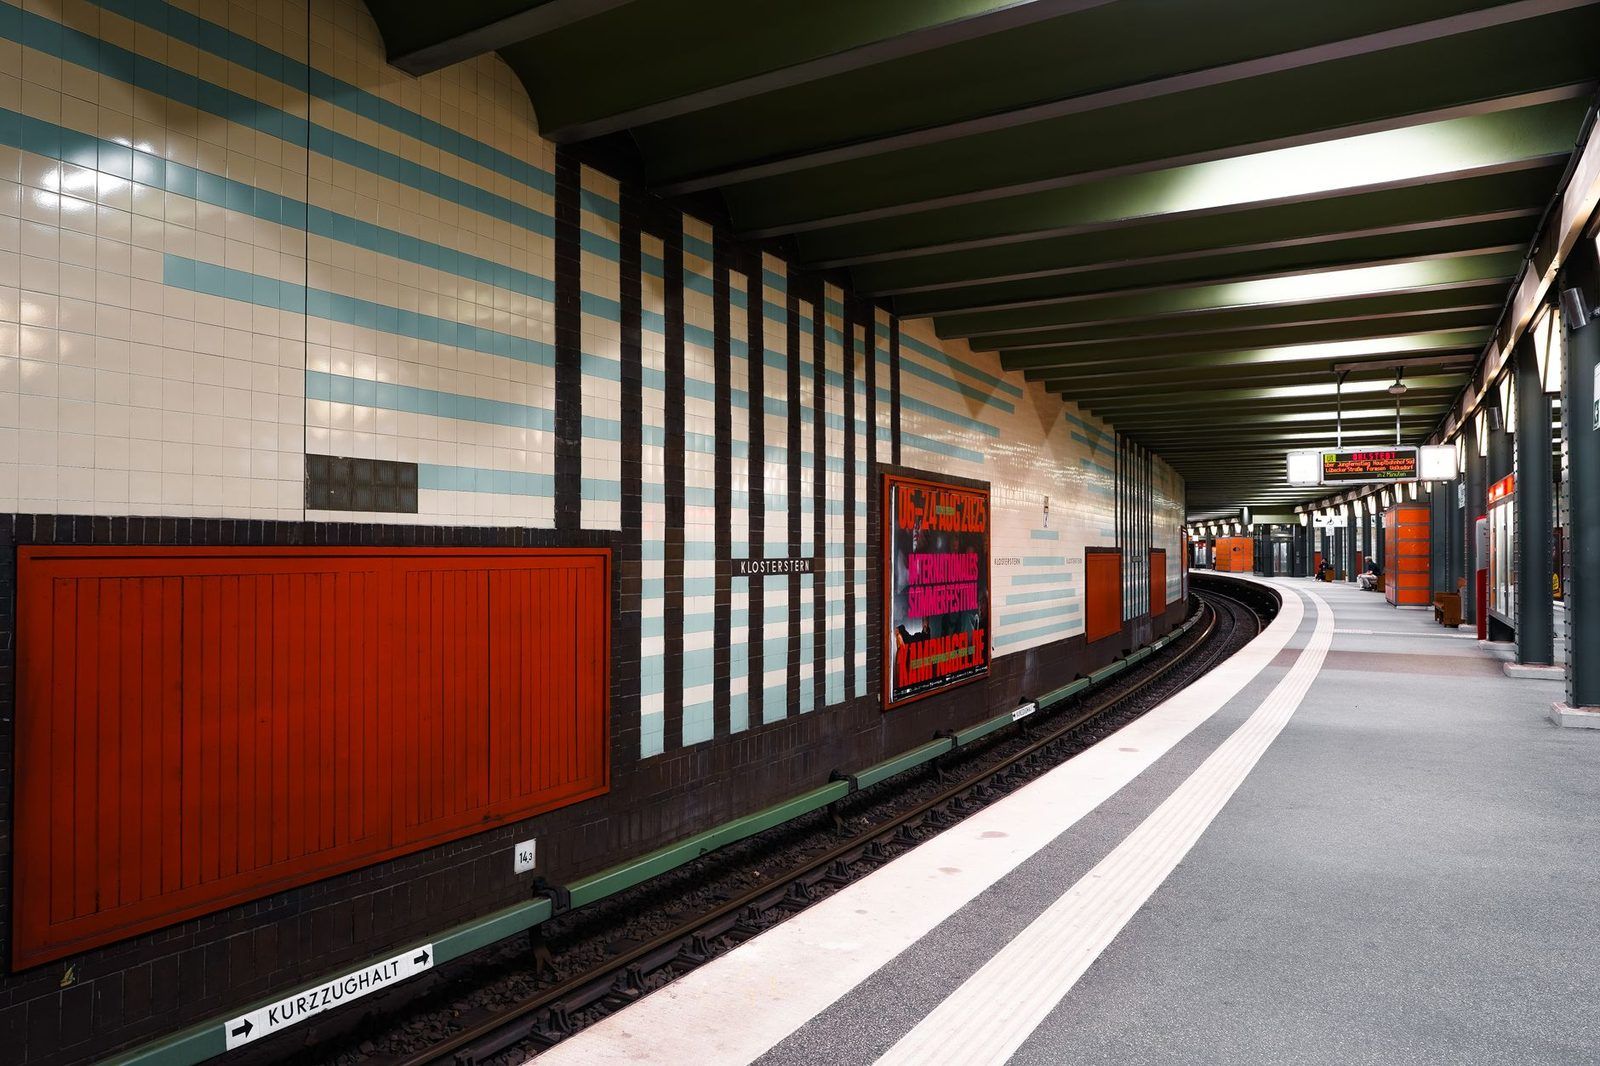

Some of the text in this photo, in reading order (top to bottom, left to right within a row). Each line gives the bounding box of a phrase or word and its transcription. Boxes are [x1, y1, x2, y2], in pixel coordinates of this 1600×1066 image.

[961, 496, 985, 532] 2025
[741, 560, 810, 574] KLOSTERSTERN
[908, 553, 978, 585] INTERNATIONALES
[908, 583, 978, 619] SOMMERFESTIVAL
[268, 961, 399, 1026] KURZZUGHALT
